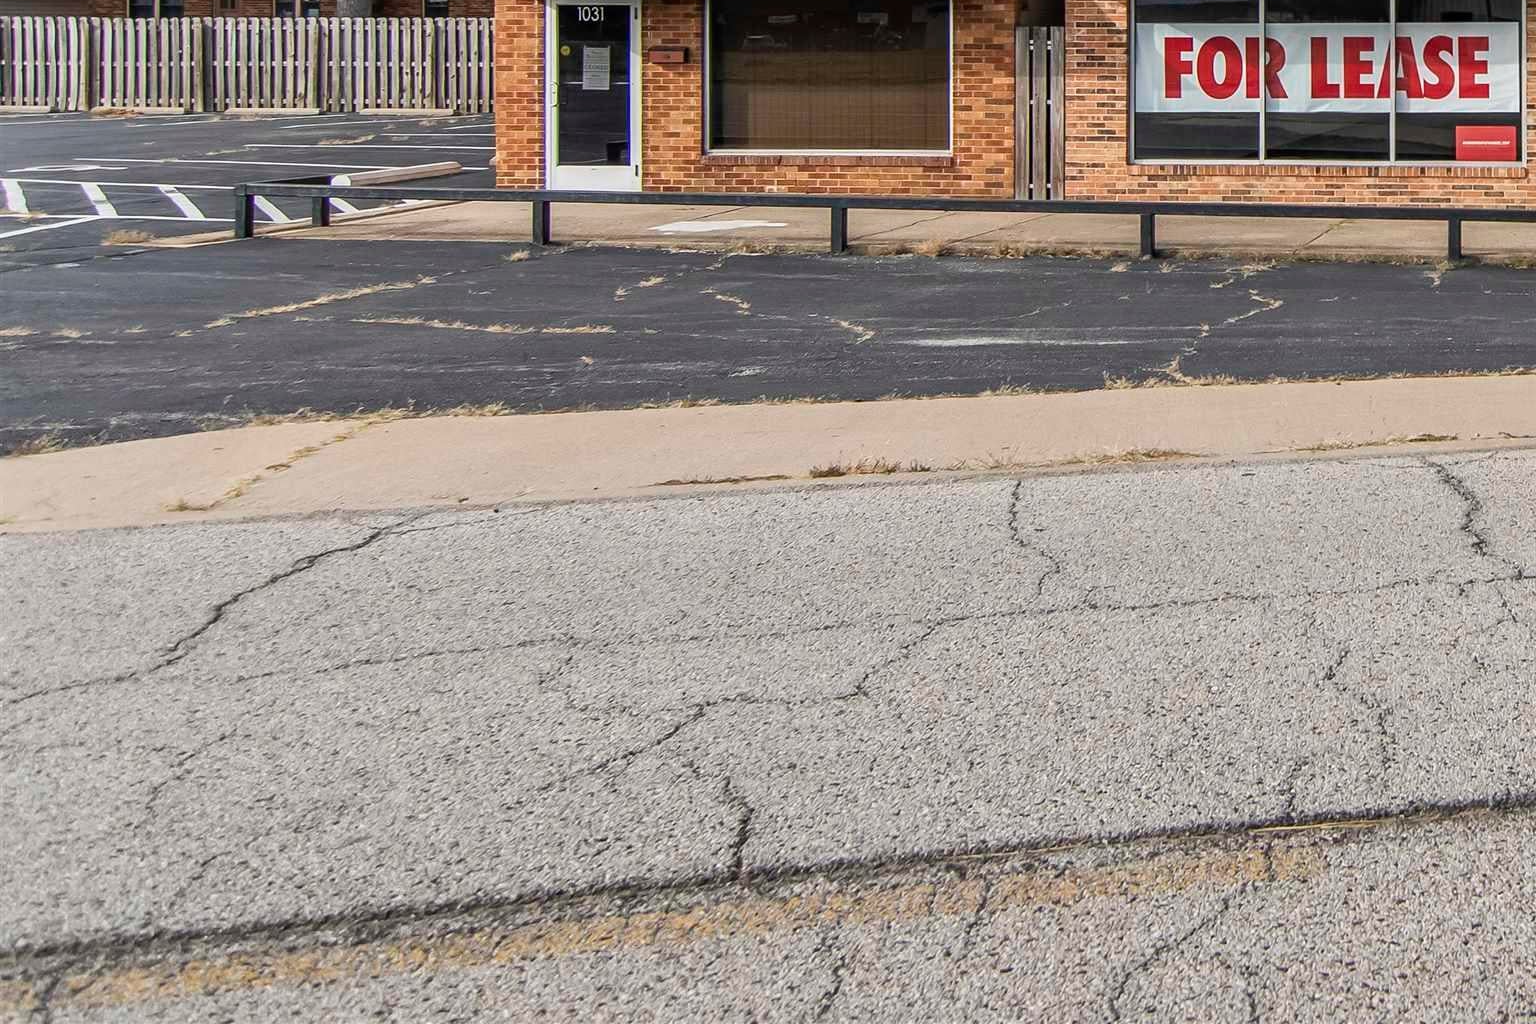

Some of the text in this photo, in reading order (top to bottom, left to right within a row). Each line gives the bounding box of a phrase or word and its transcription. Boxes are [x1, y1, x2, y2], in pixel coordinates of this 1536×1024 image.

[577, 6, 604, 22] 1031
[1163, 36, 1490, 100] FOR LEASE
